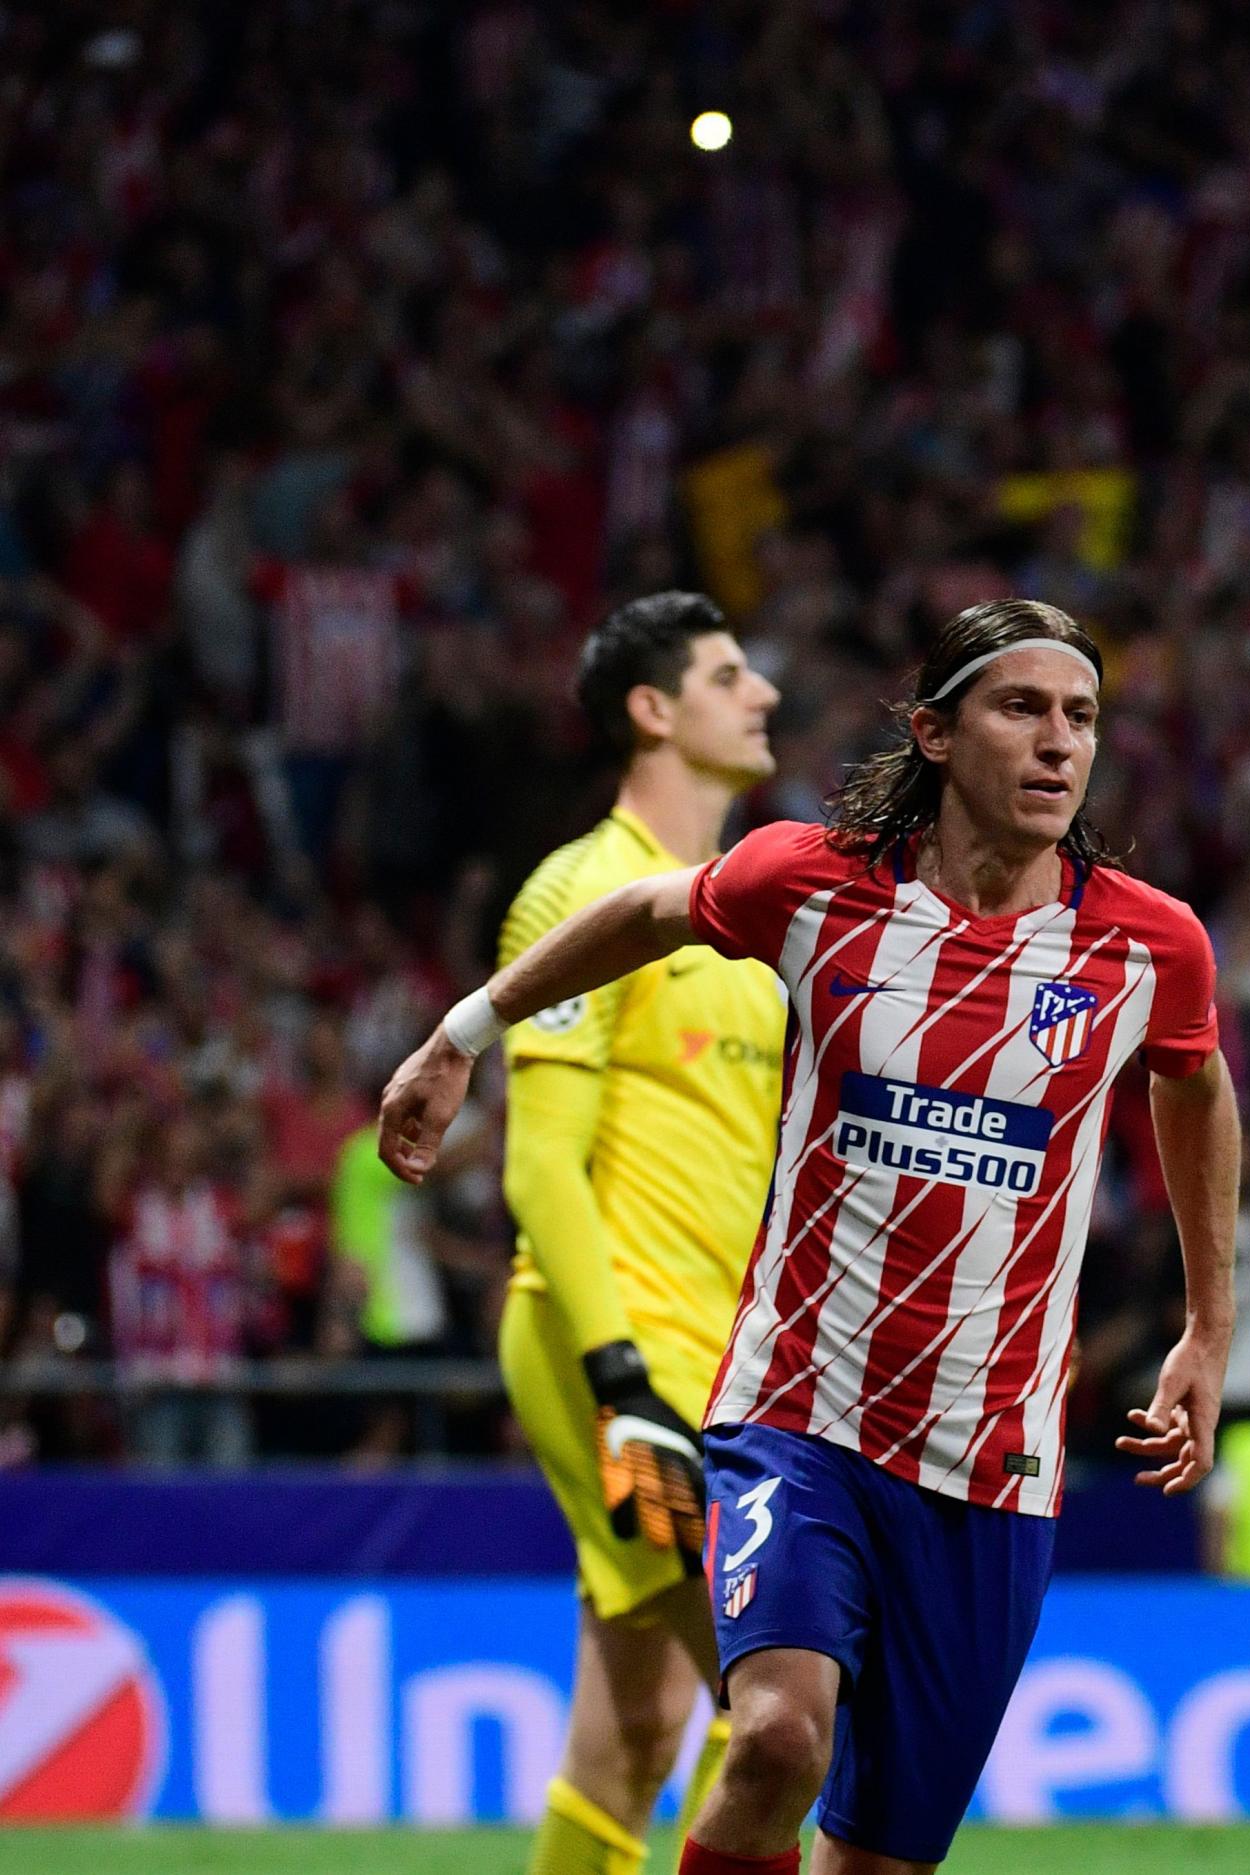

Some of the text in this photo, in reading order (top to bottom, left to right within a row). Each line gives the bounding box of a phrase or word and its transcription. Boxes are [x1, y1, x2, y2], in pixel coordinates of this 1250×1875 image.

[886, 1083, 1007, 1139] Trade
[837, 1122, 1036, 1192] Plus500
[722, 1476, 783, 1572] 3
